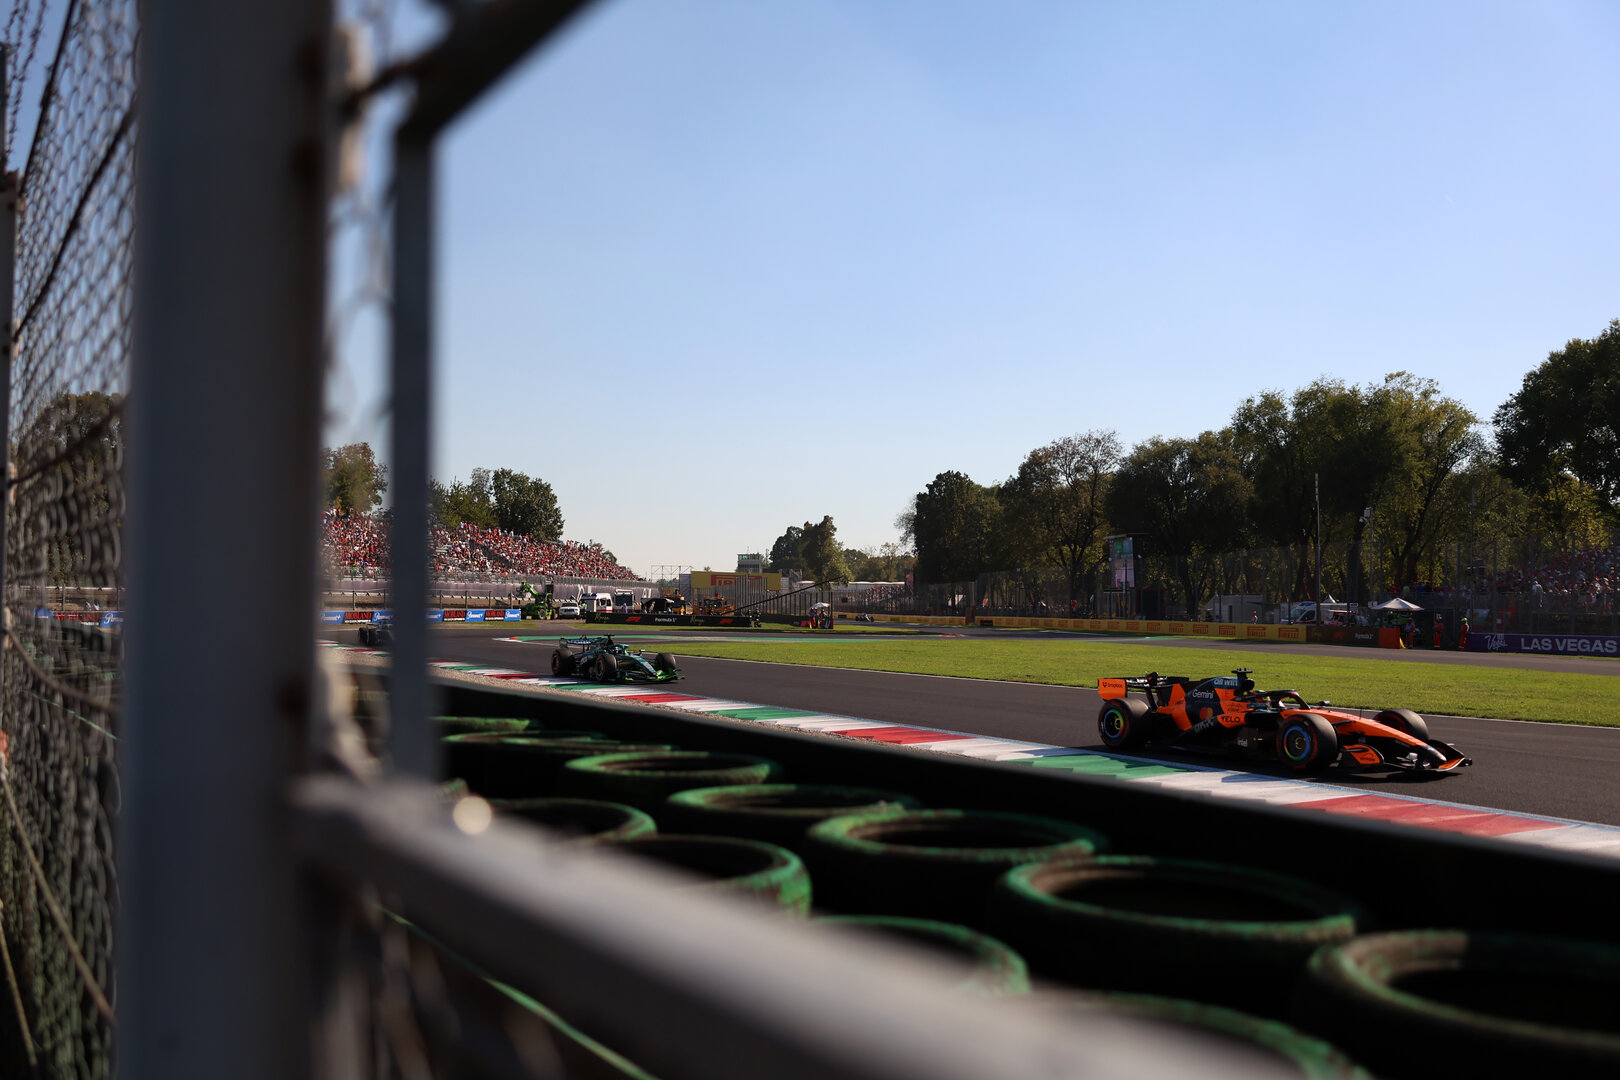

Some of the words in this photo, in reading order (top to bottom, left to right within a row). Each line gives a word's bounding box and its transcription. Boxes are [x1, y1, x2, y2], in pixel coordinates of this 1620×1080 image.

[1521, 637, 1553, 651] LAS
[1554, 638, 1618, 653] VEGAS
[1192, 689, 1214, 699] Gemini
